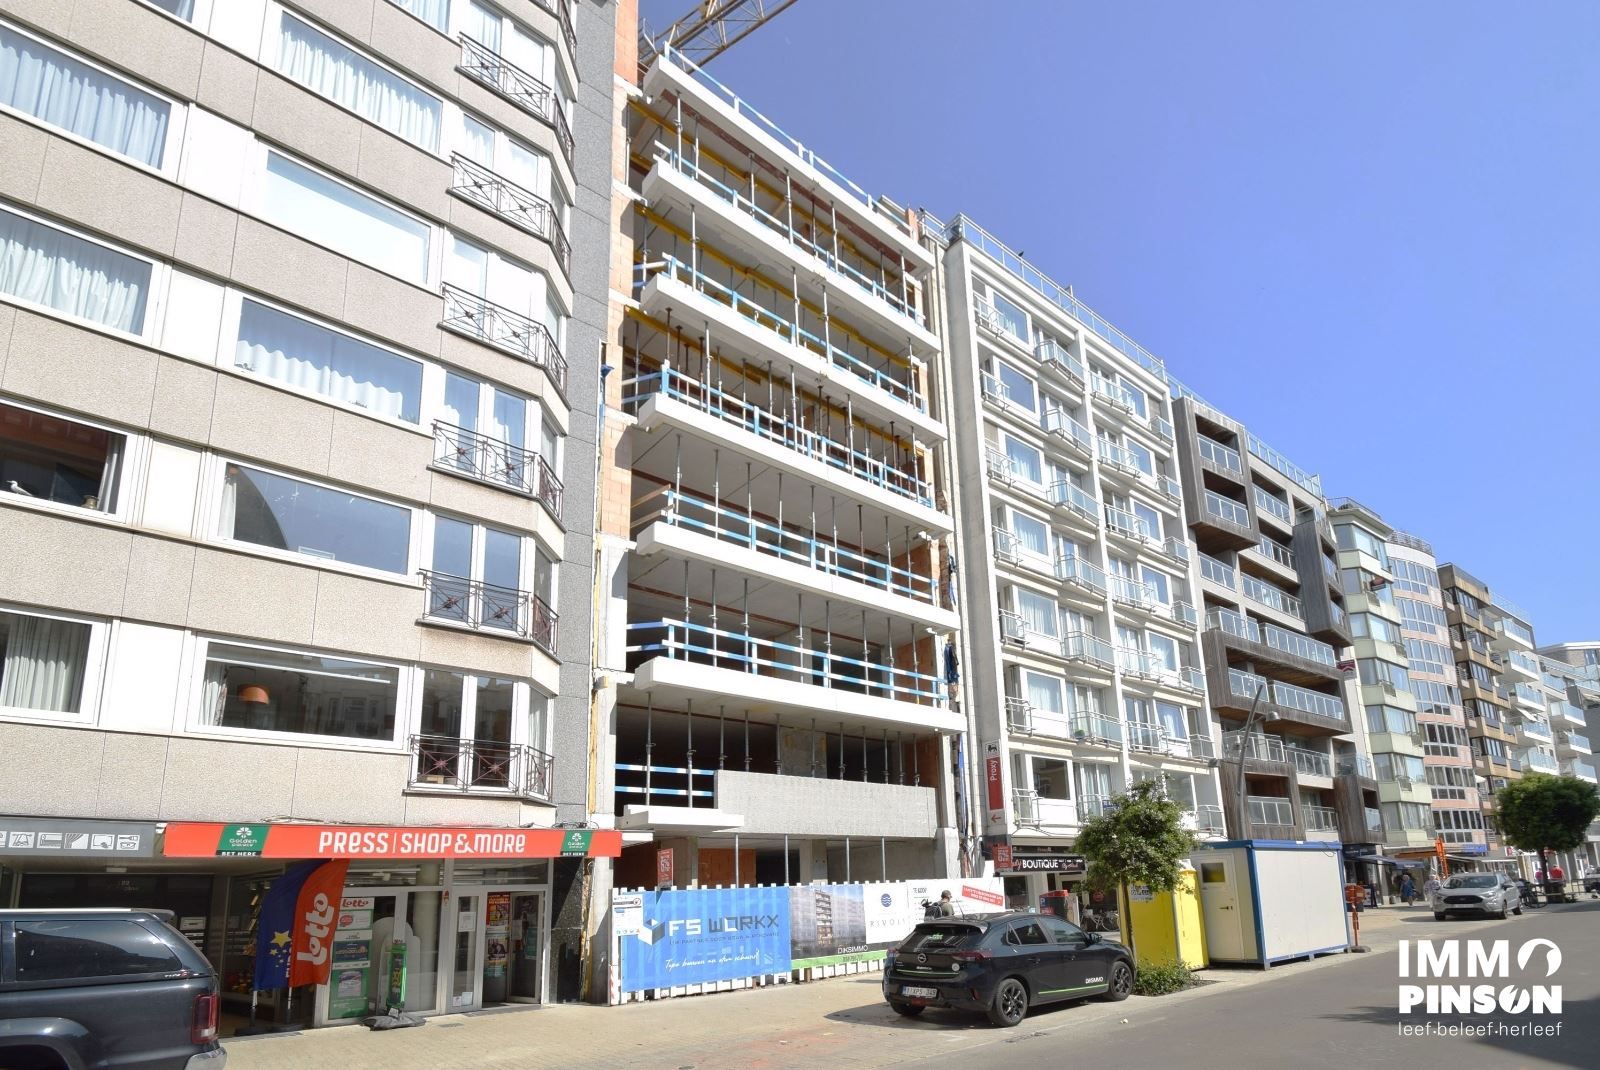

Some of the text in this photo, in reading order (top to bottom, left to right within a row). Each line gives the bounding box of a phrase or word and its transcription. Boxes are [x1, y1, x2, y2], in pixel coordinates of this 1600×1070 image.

[990, 760, 999, 781] Proxy
[1022, 859, 1059, 869] BOUTIQUE
[342, 898, 369, 907] Lotto
[296, 892, 334, 965] Lotto
[669, 914, 779, 936] FS WORKX
